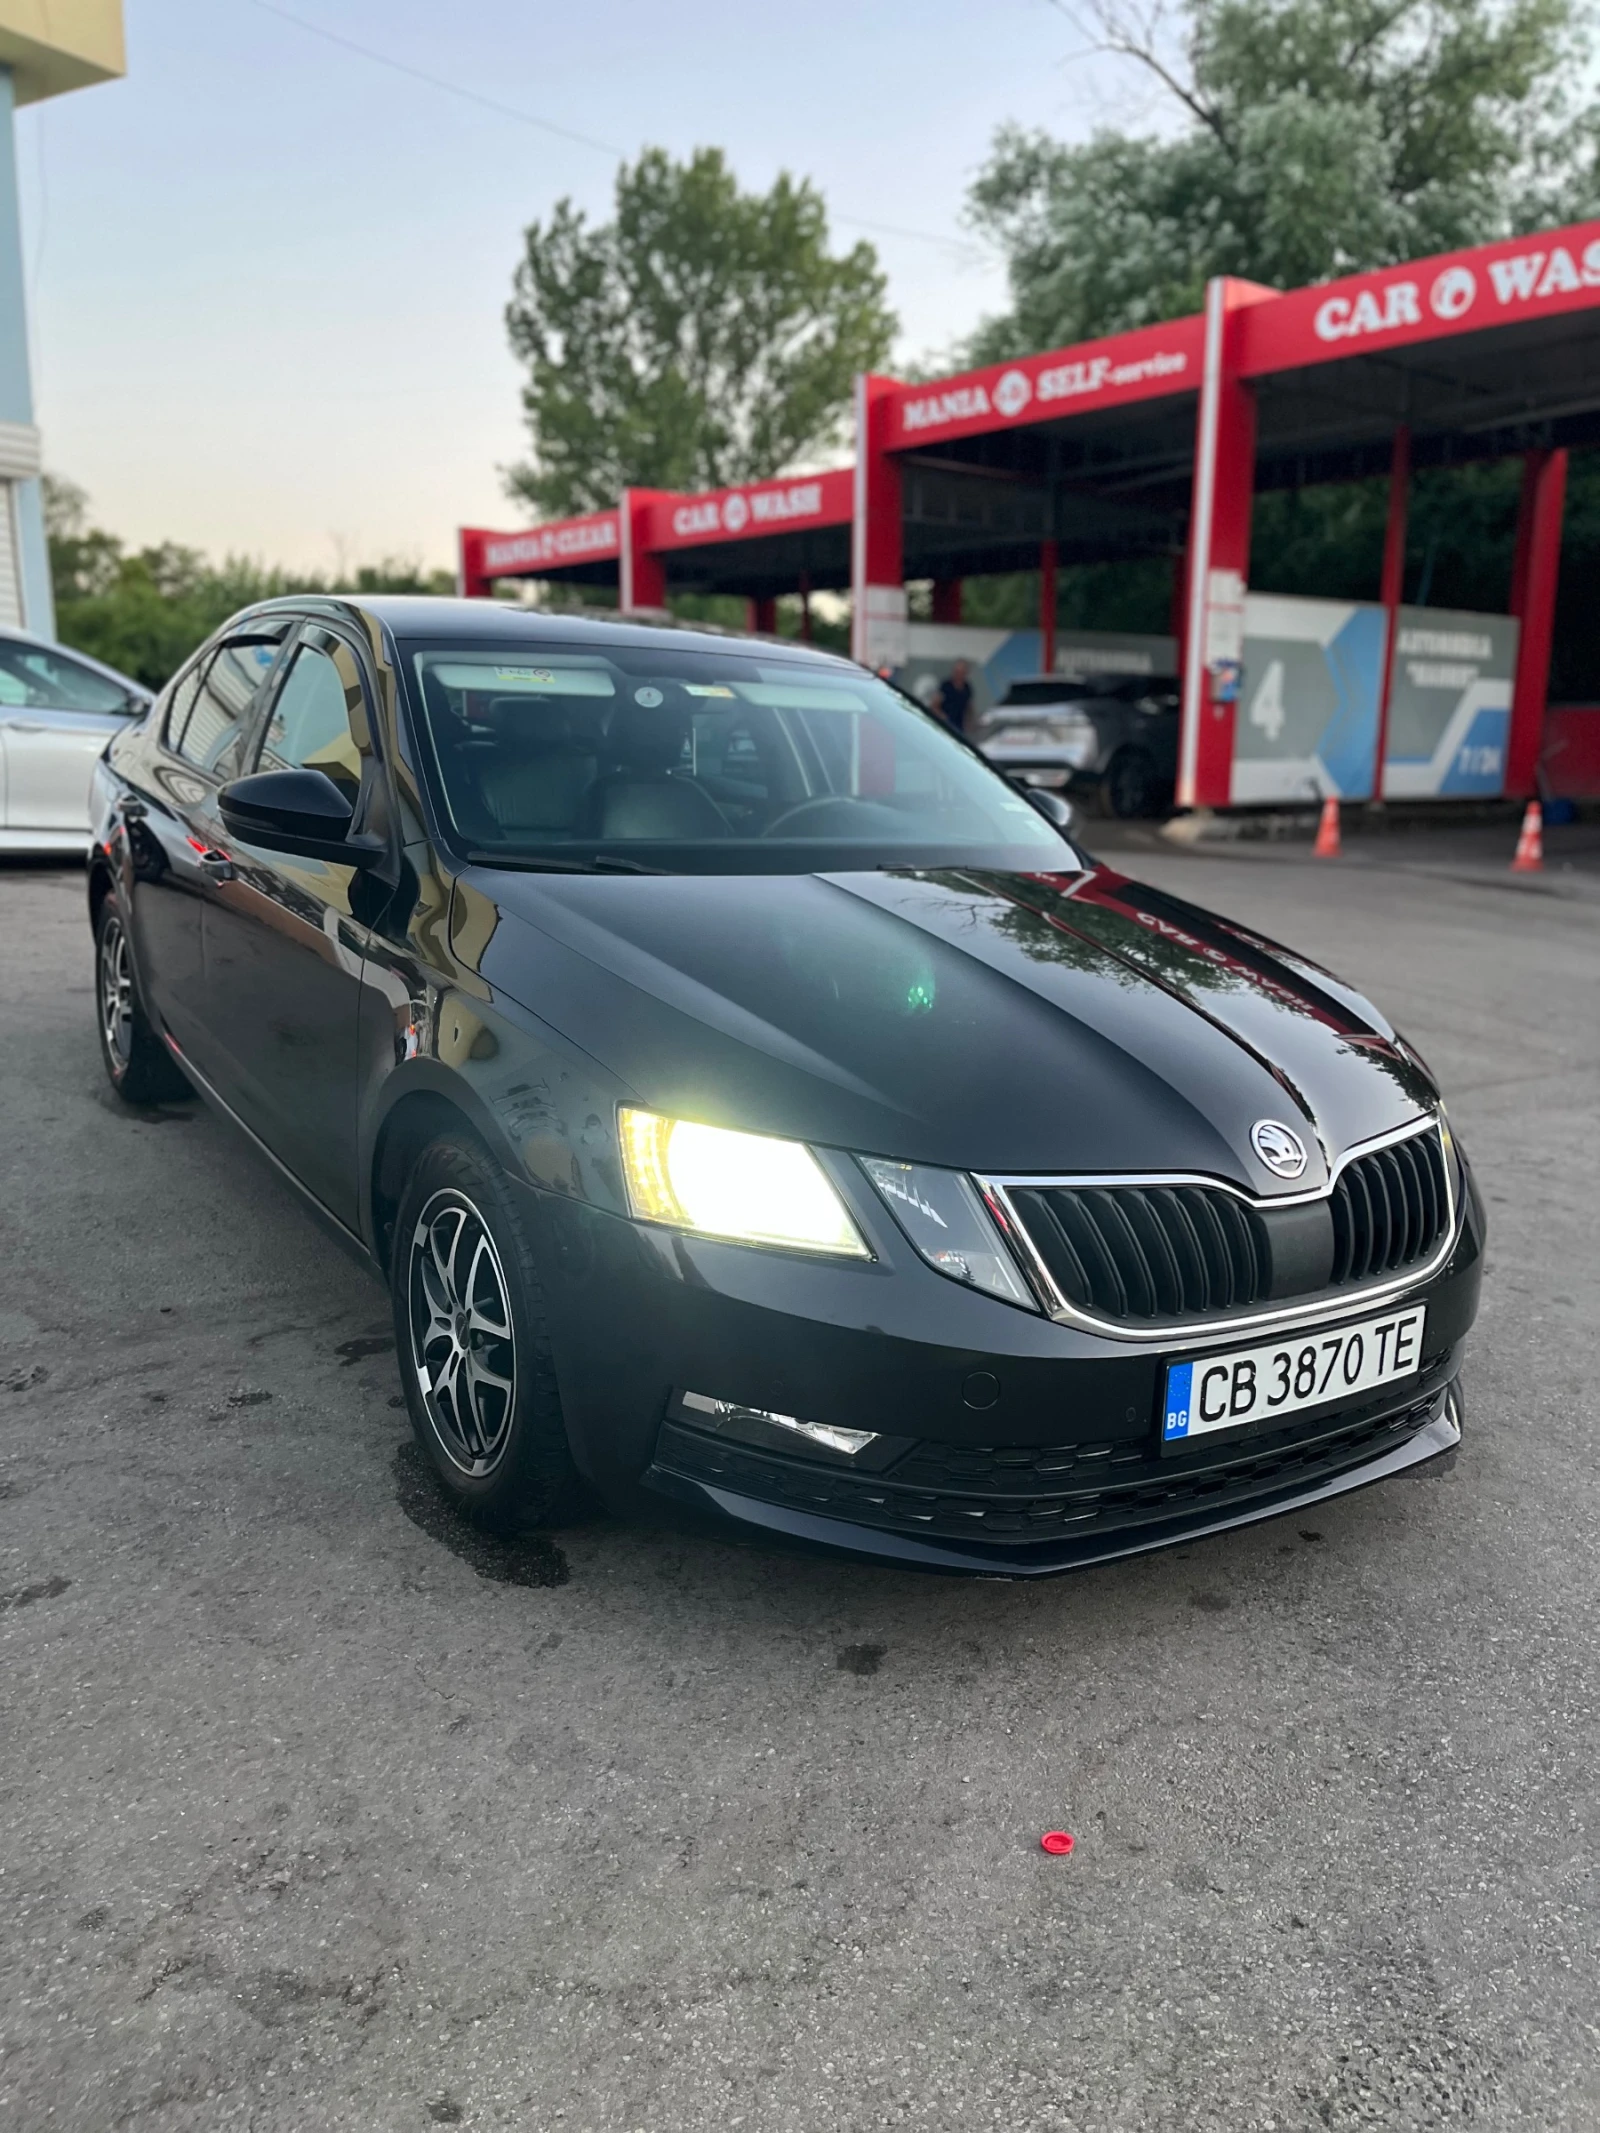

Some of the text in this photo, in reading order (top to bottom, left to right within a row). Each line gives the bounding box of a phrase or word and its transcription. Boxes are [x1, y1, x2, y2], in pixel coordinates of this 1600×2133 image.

[1314, 281, 1422, 341] CAR
[903, 386, 991, 430] MANIA
[673, 483, 822, 536] CAR WASH
[1250, 660, 1285, 742] 4
[1199, 1316, 1418, 1423] CB 3870 TE
[1166, 1411, 1188, 1430] BG
